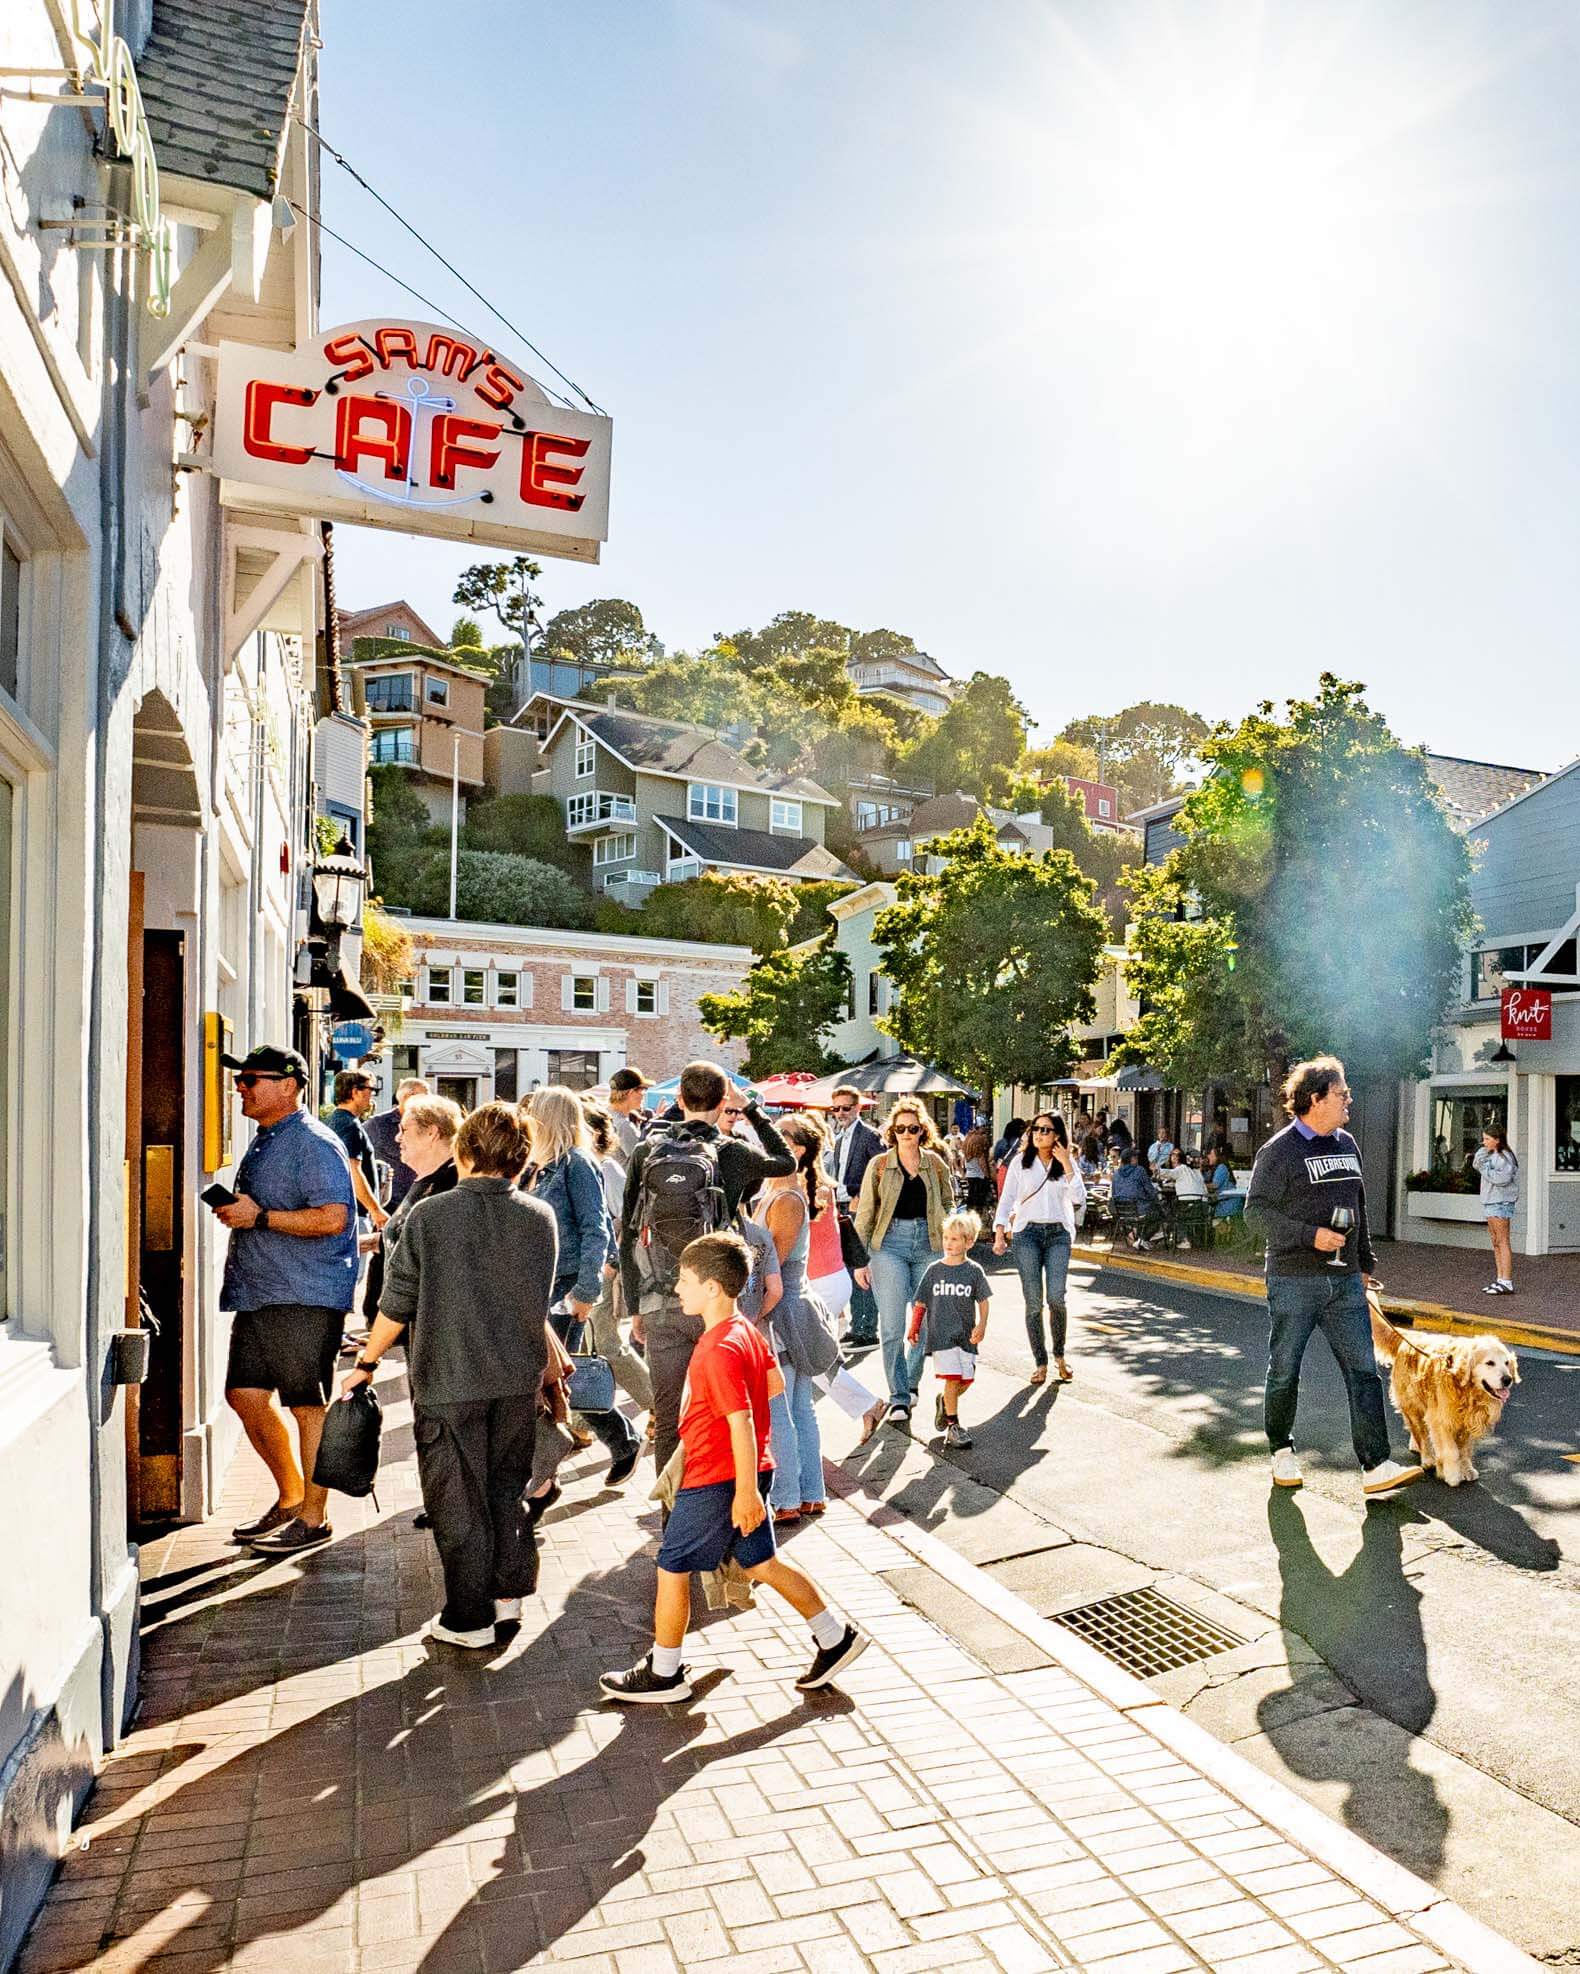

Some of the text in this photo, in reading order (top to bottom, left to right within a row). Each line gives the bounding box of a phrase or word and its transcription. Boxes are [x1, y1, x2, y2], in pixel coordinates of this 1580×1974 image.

[323, 328, 524, 410] SAM'S
[243, 380, 592, 513] CAFE
[1503, 992, 1549, 1025] knit
[932, 1279, 972, 1297] cinco
